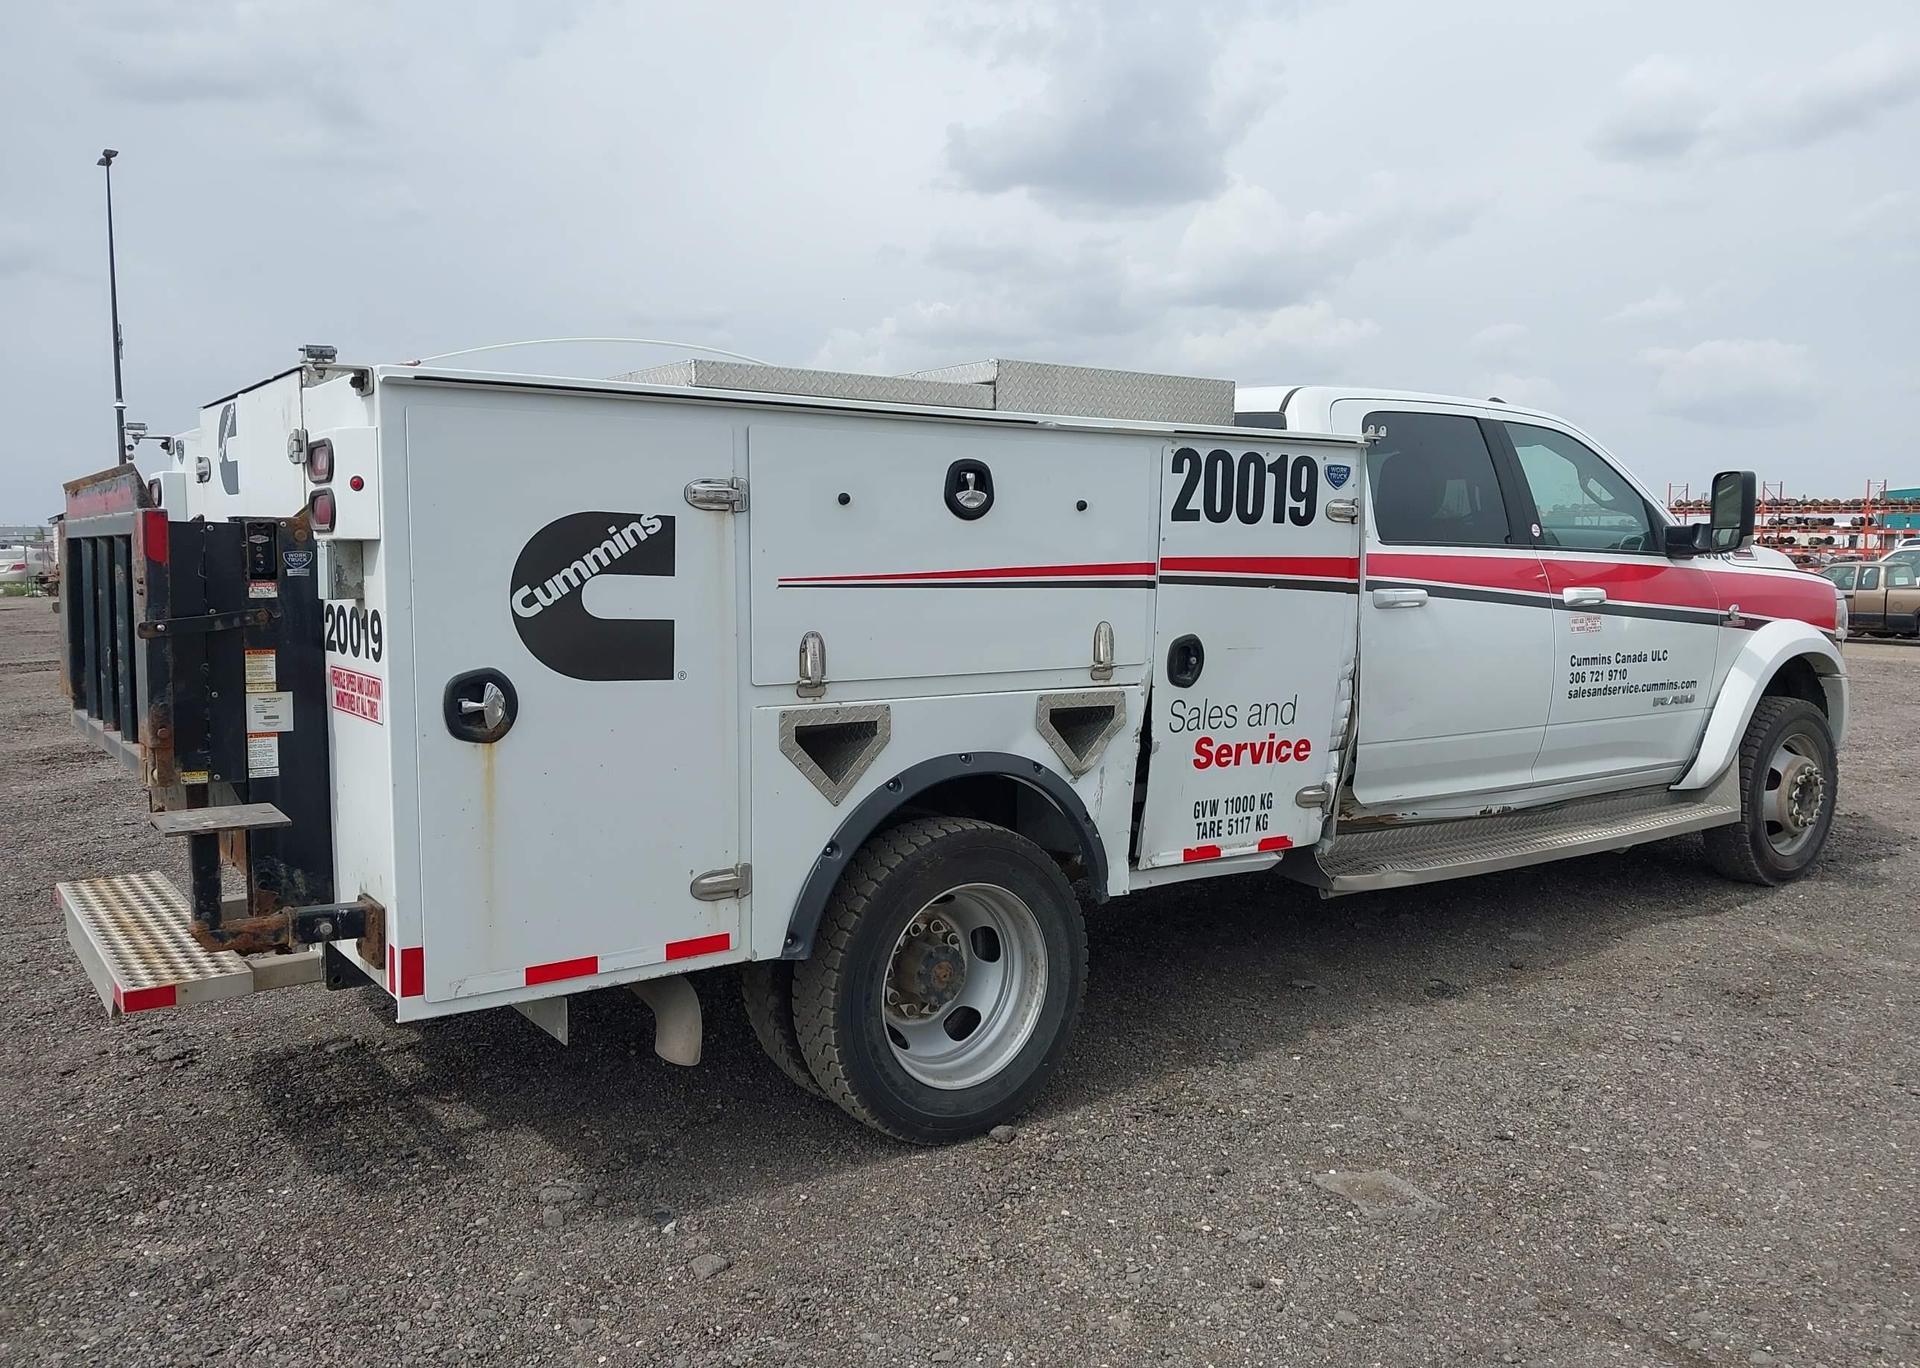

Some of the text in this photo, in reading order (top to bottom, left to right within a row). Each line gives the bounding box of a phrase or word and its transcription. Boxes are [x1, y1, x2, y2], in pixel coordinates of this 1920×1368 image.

[1171, 447, 1319, 527] 20019
[511, 512, 662, 618] Cummins
[325, 603, 383, 663] 20019
[1570, 649, 1668, 667] Cummins Canada ULC
[1567, 679, 1698, 700] salesandservice.cummins.com
[1569, 668, 1628, 684] 306 721 9710
[1168, 694, 1298, 733] Sales and
[1193, 733, 1311, 769] Service
[1193, 792, 1273, 819] GVW 11000 KG
[1195, 813, 1269, 840] TARE 5117 KG
